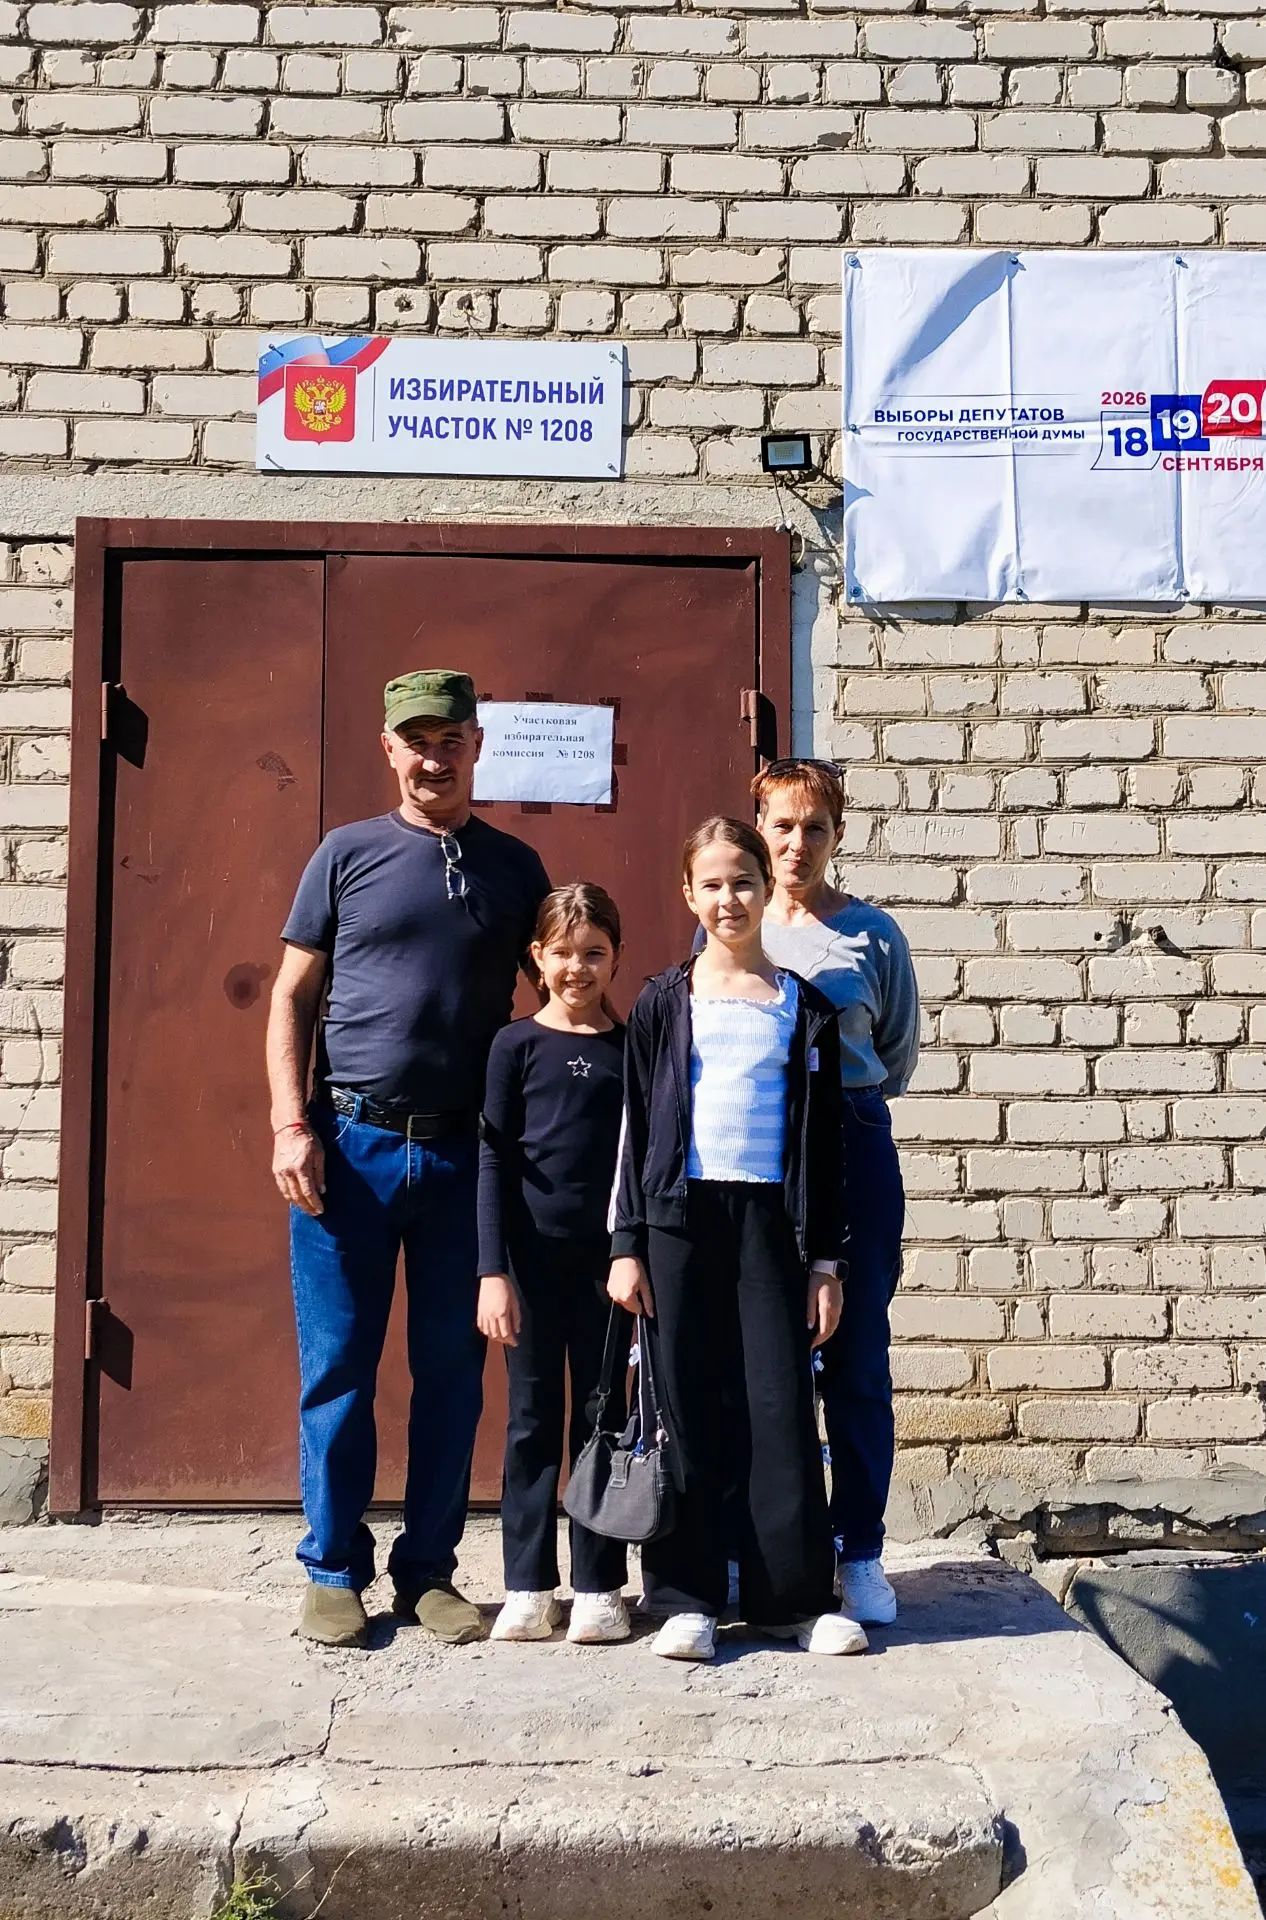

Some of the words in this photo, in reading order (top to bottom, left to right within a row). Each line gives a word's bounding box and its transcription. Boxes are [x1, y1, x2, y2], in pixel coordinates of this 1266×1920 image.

[389, 376, 604, 405] ИЗБИРАТЕЛЬНЫЙ
[1101, 392, 1147, 405] 2026
[874, 409, 954, 423] ВЫБОРЫ
[959, 408, 1065, 423] ДЕПУТАТОВ
[389, 416, 496, 440] УЧАСТОК
[505, 419, 532, 440] №
[540, 419, 593, 442] 1208
[1107, 427, 1149, 457] 18
[1156, 409, 1198, 440] 19
[1207, 392, 1258, 424] 20
[898, 428, 1039, 442] ГОСУДАРСТВЕННОЙ
[1042, 429, 1085, 440] ДУМЫ
[1162, 457, 1264, 471] СЕНТЯБРЯ
[513, 714, 577, 726] Участковая
[504, 731, 585, 743] избирательная
[492, 749, 544, 758] комиссия
[572, 750, 595, 759] 1208
